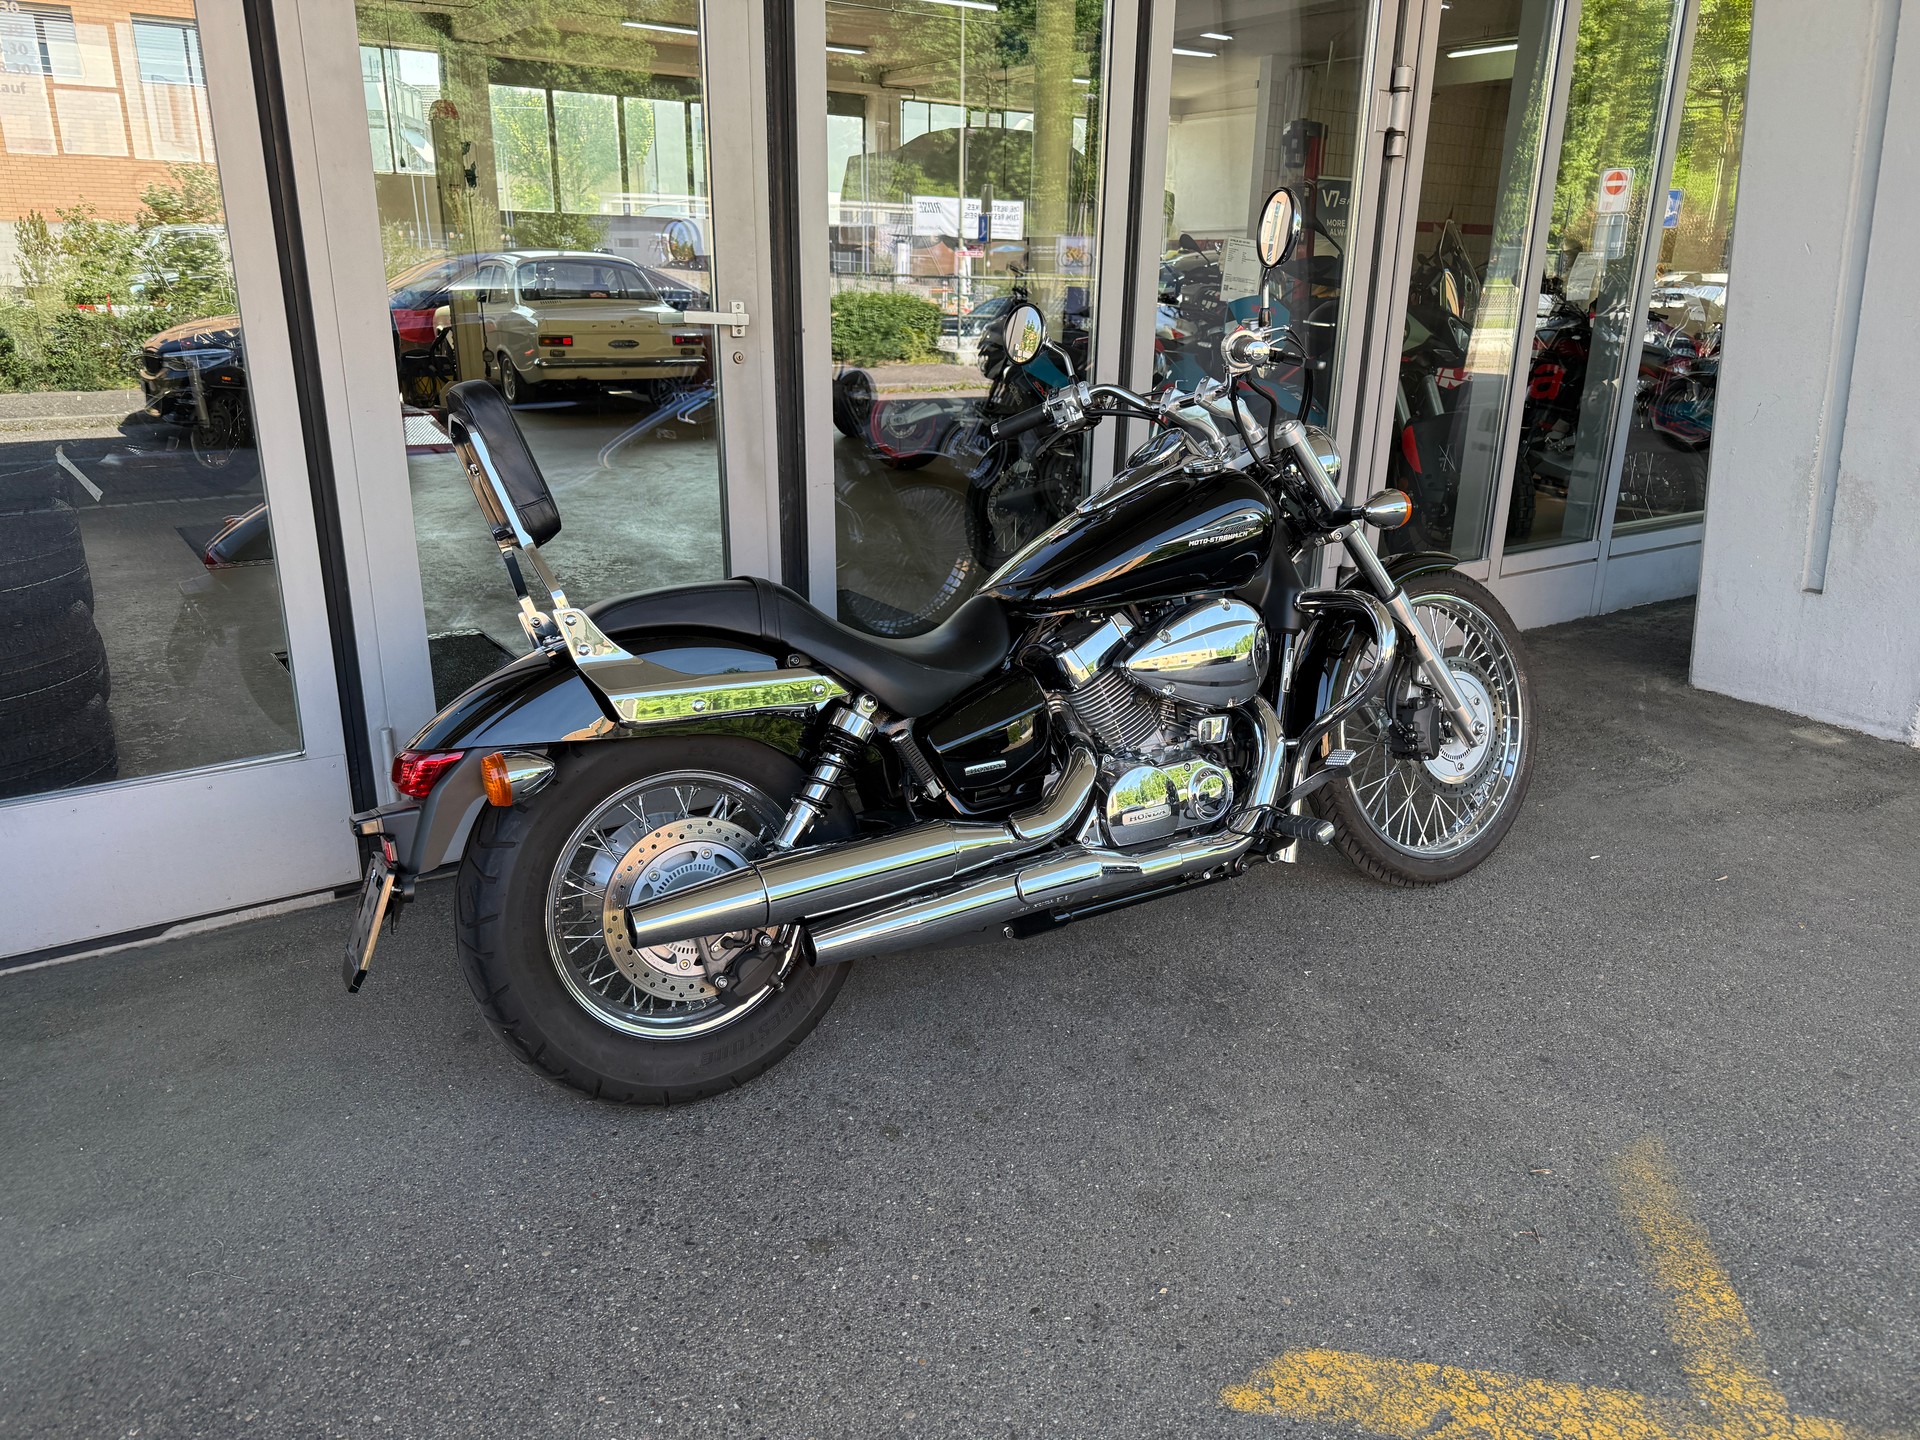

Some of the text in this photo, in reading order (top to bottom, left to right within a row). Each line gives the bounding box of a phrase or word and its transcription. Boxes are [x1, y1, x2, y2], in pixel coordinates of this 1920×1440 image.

[1322, 189, 1340, 208] V7
[1327, 219, 1345, 228] MORE
[970, 763, 1001, 774] HONDA
[1129, 810, 1166, 822] HONDA
